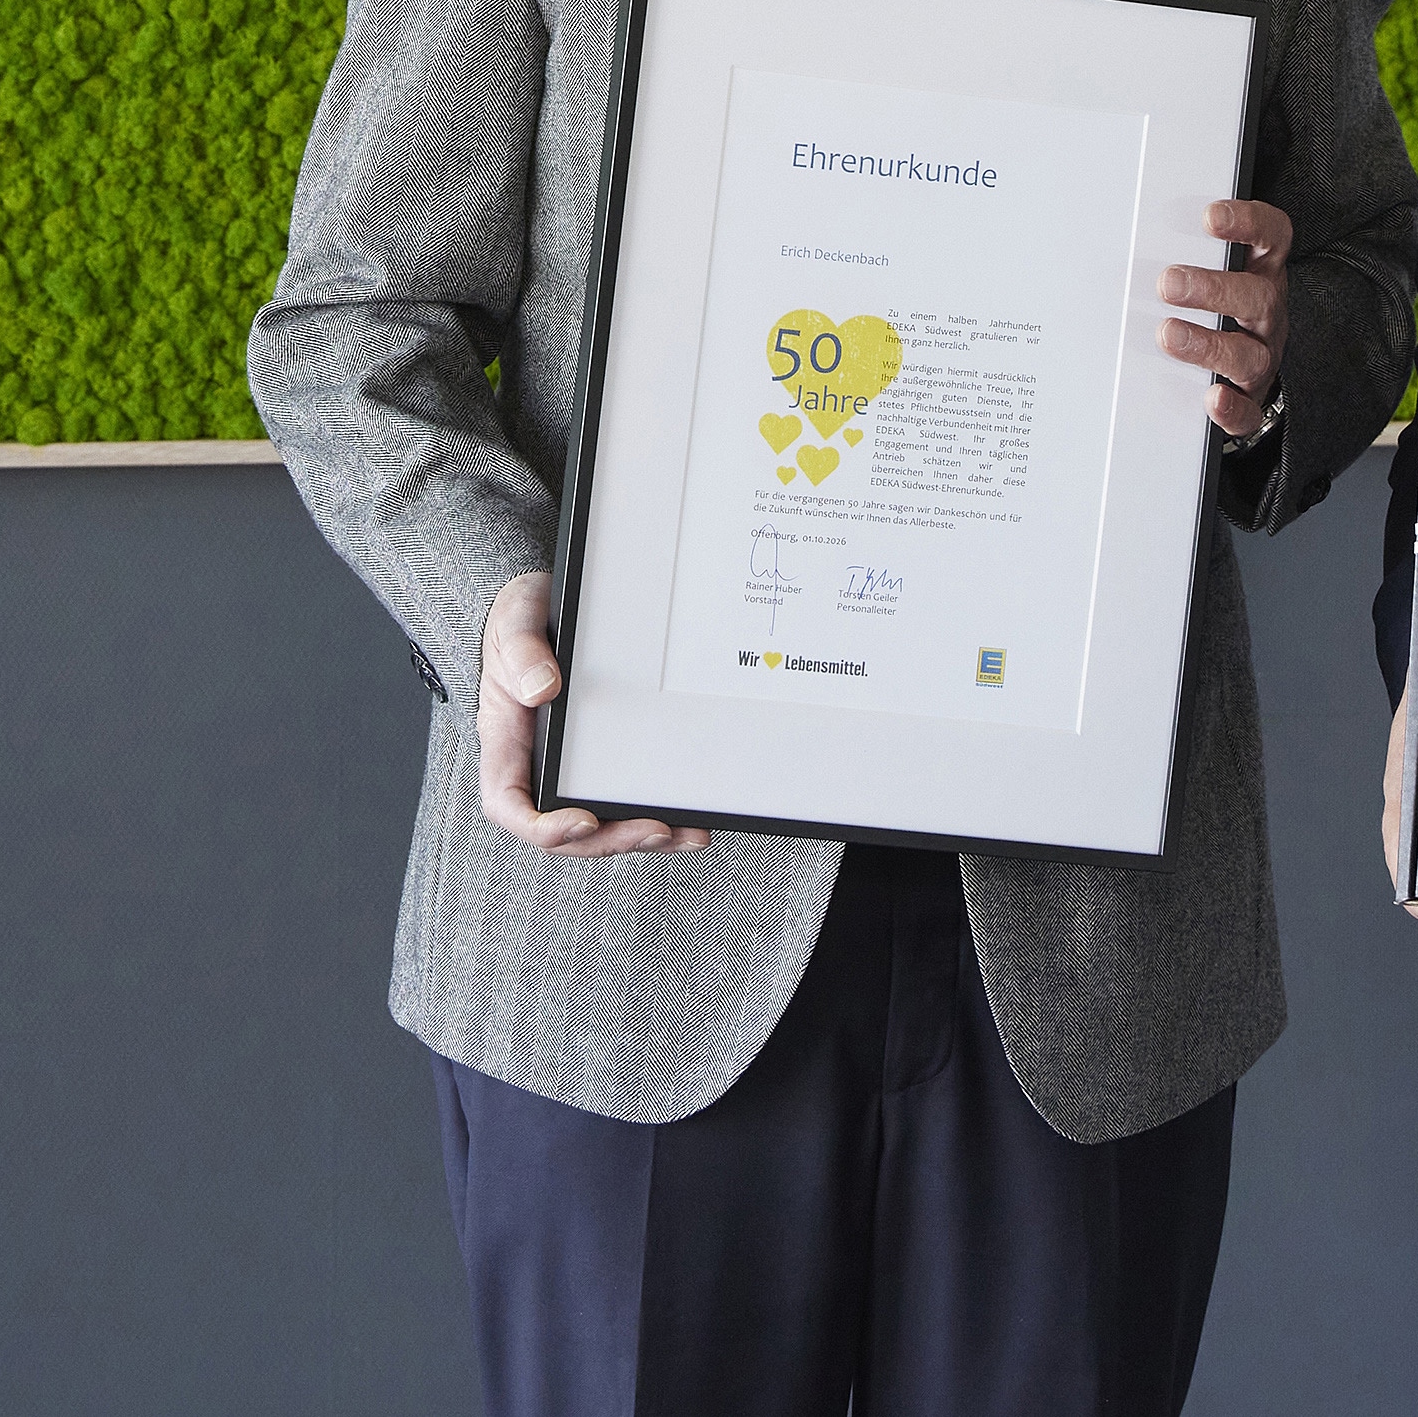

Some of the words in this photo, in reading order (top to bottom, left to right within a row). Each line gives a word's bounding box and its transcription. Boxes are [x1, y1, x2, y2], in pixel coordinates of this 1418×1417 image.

[792, 142, 997, 188] Ehrenurkunde
[781, 245, 811, 258] Erich
[814, 248, 889, 266] Deckenbach
[887, 308, 899, 318] Zu
[910, 311, 937, 321] einem
[948, 315, 978, 326] halben
[988, 319, 1041, 332] Jahrhundert
[885, 334, 910, 345] Ihnen
[910, 338, 932, 349] ganz
[934, 339, 970, 351] herzlich.
[886, 321, 916, 334] EDEKA
[924, 325, 962, 337] Südwest
[969, 331, 1018, 343] gratulieren
[1026, 336, 1040, 345] wir
[771, 327, 842, 382] 50
[882, 361, 898, 369] Wir
[902, 363, 943, 376] würdigen
[947, 366, 978, 378] hiermit
[982, 372, 1037, 384] ausdrücklich
[881, 373, 899, 383] Ihre
[902, 376, 982, 392] außergewöhnliche
[986, 383, 1013, 396] Treue,
[1017, 387, 1035, 397] Ihre
[788, 385, 868, 415] Jahre
[879, 386, 933, 402] langjährigen
[941, 394, 968, 404] guten
[977, 396, 1012, 409] Dienste,
[1021, 400, 1033, 409] Ihr
[878, 401, 905, 410] stetes
[910, 402, 992, 418] Pflichtbewusstsein
[996, 412, 1014, 421] und
[1018, 413, 1033, 423] die
[877, 413, 928, 428] nachhaltige
[928, 417, 992, 432] Verbundenheit
[993, 424, 1009, 433] mit
[1010, 425, 1031, 435] Ihrer
[875, 425, 905, 436] EDEKA
[919, 429, 959, 441] Südwest.
[973, 434, 986, 444] Ihr
[999, 438, 1030, 449] großes
[874, 438, 929, 452] Engagement
[935, 445, 953, 454] und
[959, 446, 982, 456] Ihren
[989, 450, 1029, 461] täglichen
[872, 451, 905, 462] Antrieb
[922, 456, 962, 468] schätzen
[978, 462, 993, 470] wir
[1010, 465, 1027, 474] und
[871, 464, 924, 477] überreichen
[933, 470, 958, 480] Ihnen
[967, 473, 994, 484] daher
[1002, 477, 1026, 487] diese
[870, 477, 900, 488] EDEKA
[901, 480, 1004, 498] Südwest-Ehrenurkunde.
[753, 503, 767, 513] die
[768, 504, 803, 516] Zukunft
[804, 508, 849, 520] wünschen
[850, 512, 865, 521] wir
[866, 513, 891, 523] Ihnen
[892, 515, 908, 526] das
[909, 517, 956, 530] Allerbeste.
[755, 489, 769, 499] Für
[771, 491, 786, 501] die
[788, 495, 845, 507] vergangenen
[847, 499, 859, 509] 50
[861, 500, 886, 510] Jahre
[888, 504, 914, 515] sagen
[916, 506, 932, 514] wir
[934, 506, 987, 519] Dankeschön
[989, 513, 1007, 522] und
[1009, 513, 1022, 523] für
[750, 528, 799, 544] Offenburg,
[802, 535, 847, 546] 01.10.2026
[745, 581, 774, 591] Rainer
[775, 582, 803, 594] Huber
[839, 588, 872, 600] Torsten
[872, 592, 898, 603] Geiler
[744, 594, 784, 606] Vorstand
[837, 602, 897, 616] Personalleiter
[738, 650, 761, 668] Wir
[784, 654, 868, 677] Lebensmittel.
